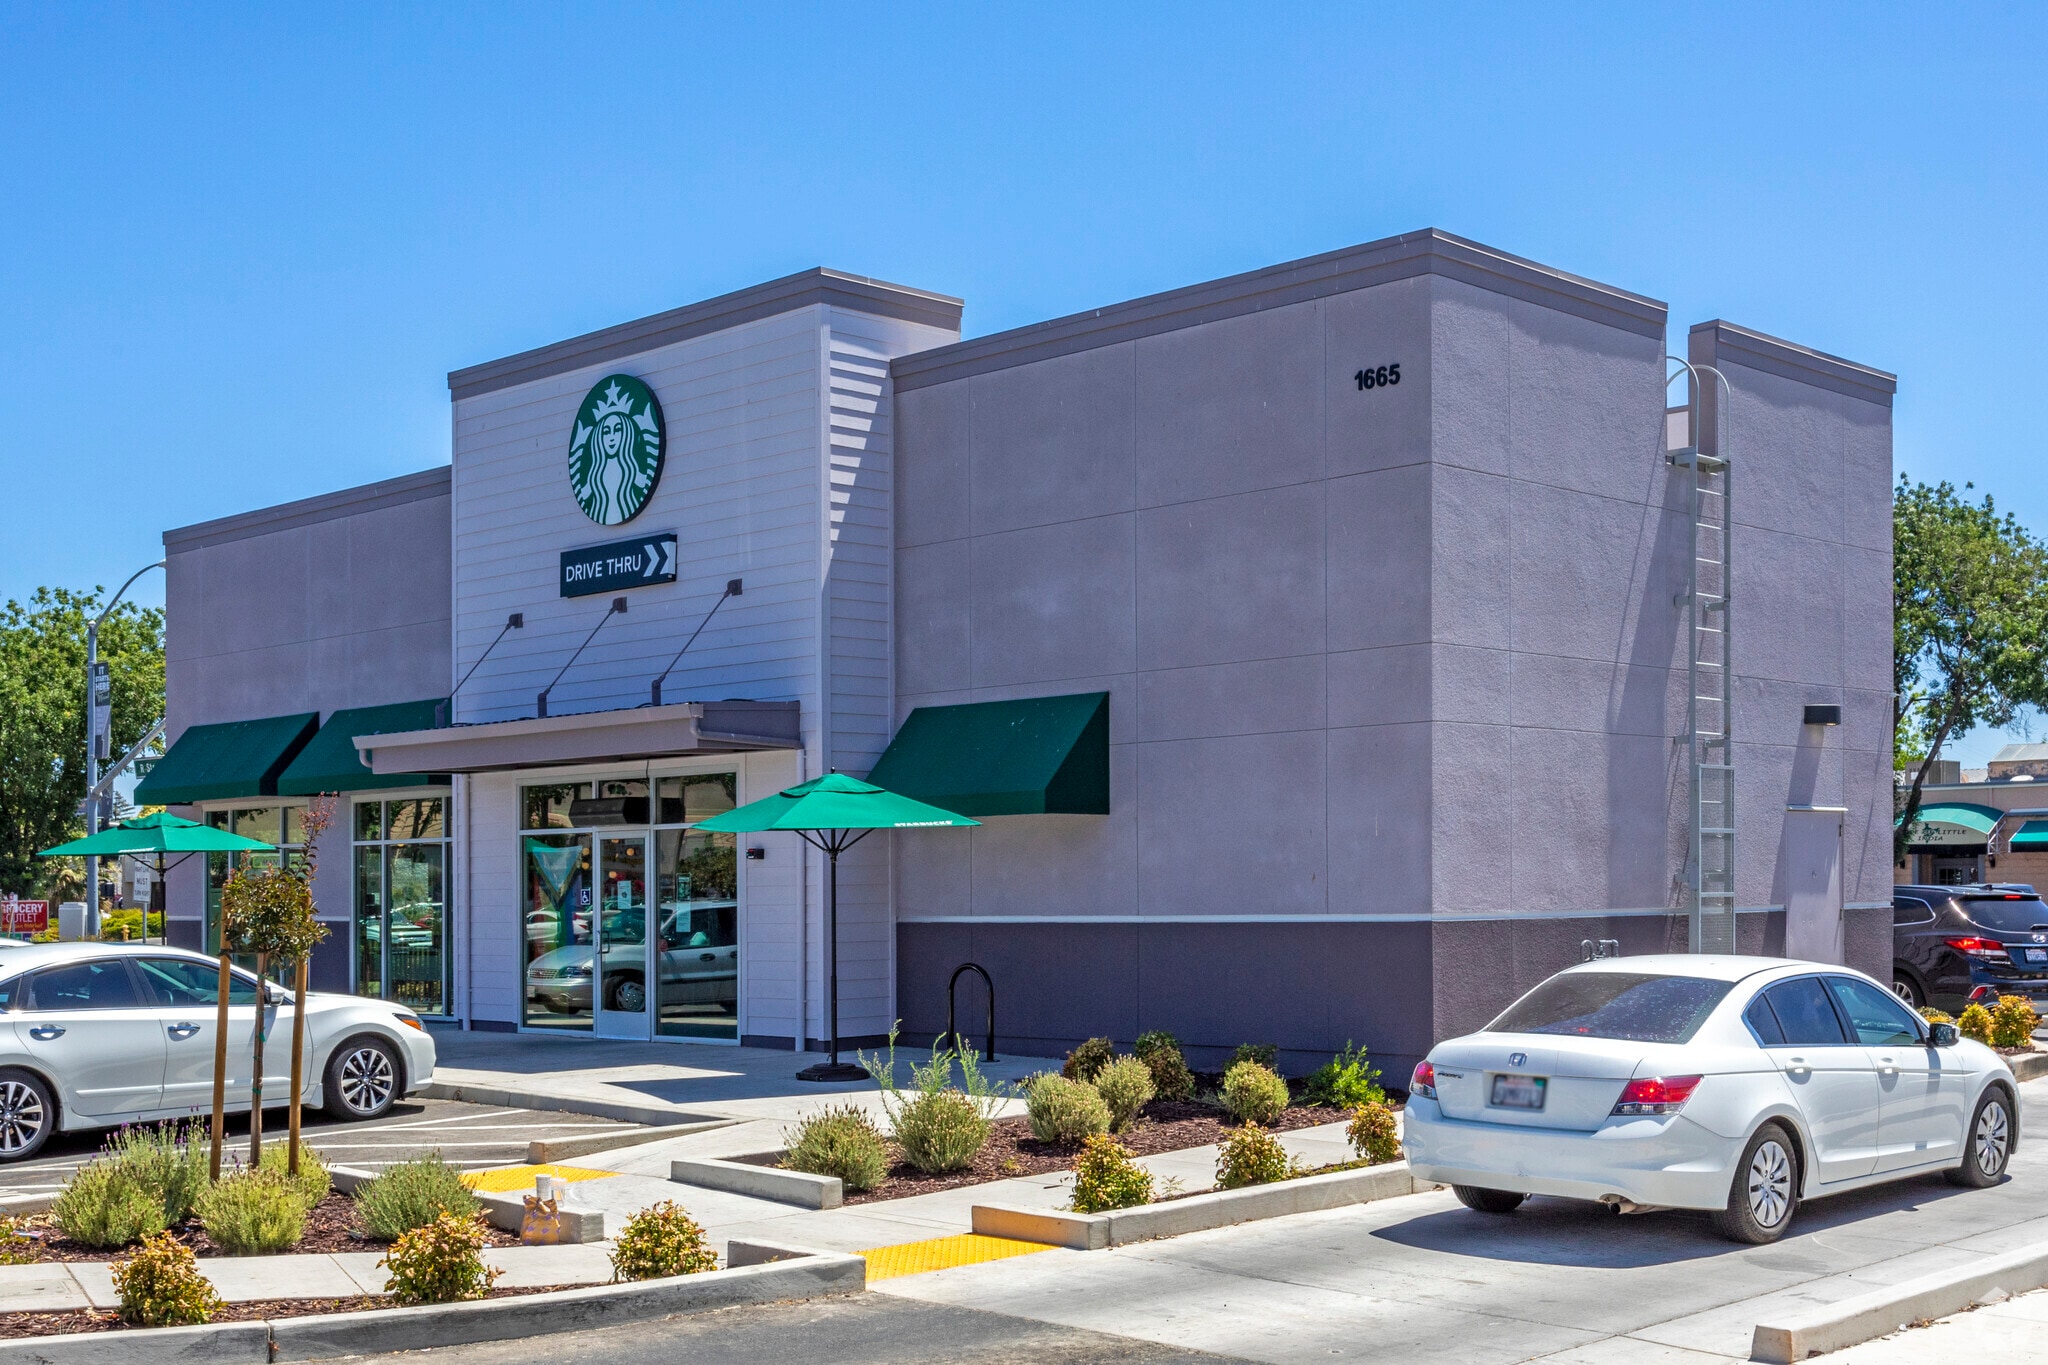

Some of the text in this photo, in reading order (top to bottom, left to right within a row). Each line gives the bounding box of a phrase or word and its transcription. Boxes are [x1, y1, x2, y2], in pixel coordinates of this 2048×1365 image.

[1354, 363, 1401, 391] 1665
[565, 554, 642, 582] DRIVE THRU
[98, 666, 105, 675] IT
[95, 682, 110, 691] HERE
[136, 878, 148, 886] MUST
[1, 903, 44, 913] GRCERY
